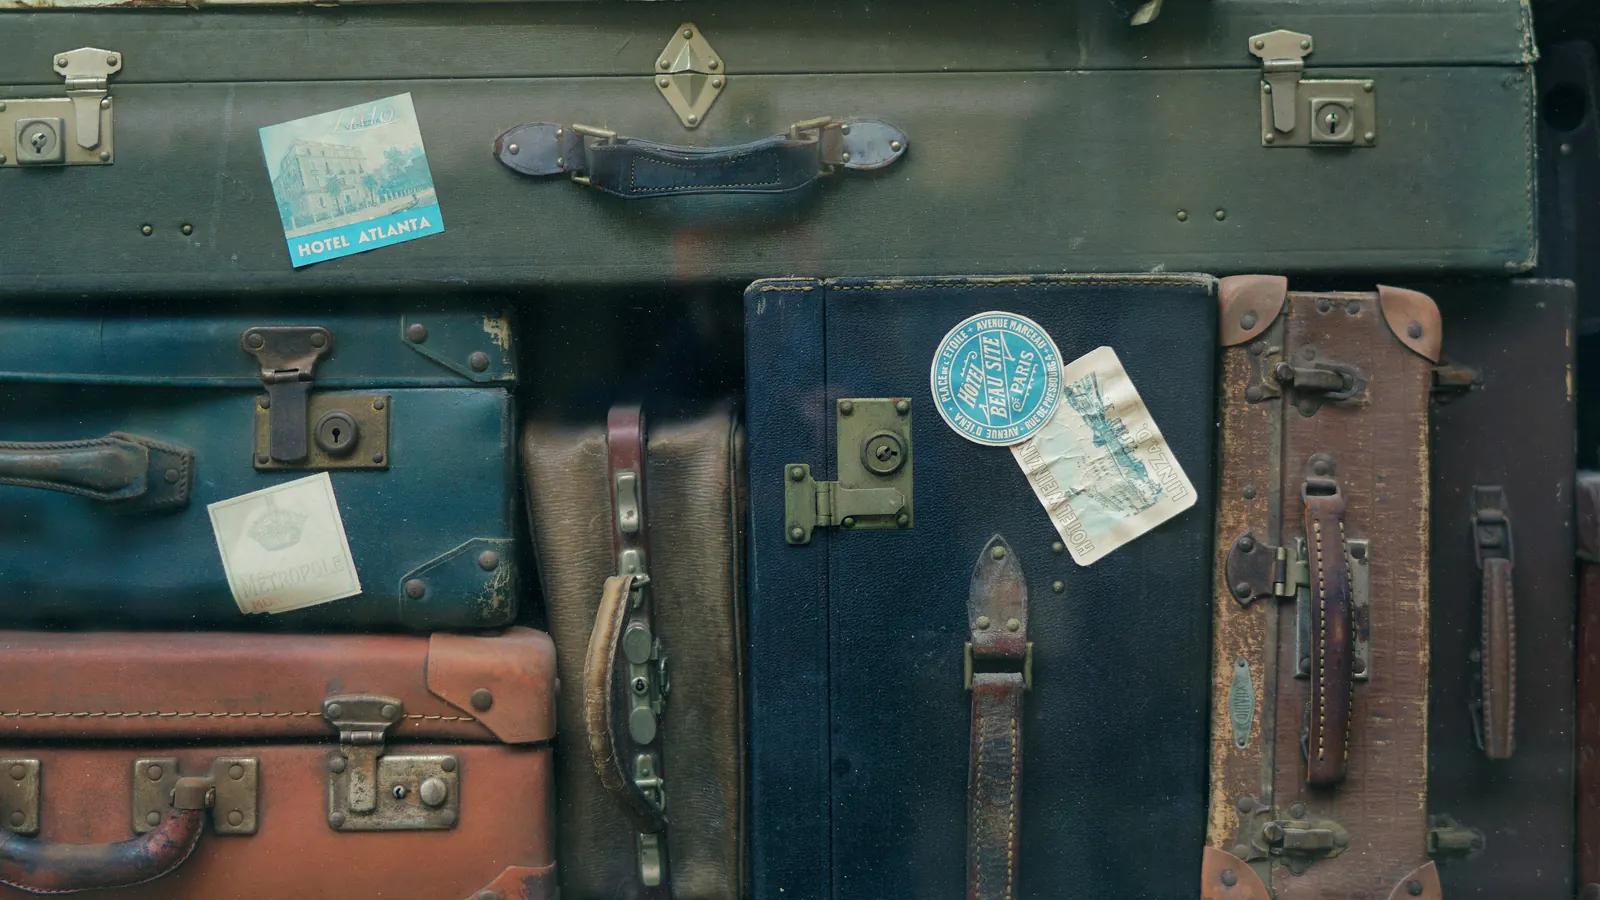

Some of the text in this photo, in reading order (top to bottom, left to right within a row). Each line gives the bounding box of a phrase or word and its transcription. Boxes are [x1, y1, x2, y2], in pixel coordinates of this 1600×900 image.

[344, 118, 382, 131] VENEZIA
[297, 216, 432, 257] HOTEL ATLANTA
[976, 318, 1047, 350] AVENUE MARCEAU
[938, 375, 951, 403] PLACE
[983, 336, 1008, 419] BEAU SITE
[1010, 350, 1034, 395] PARIS
[986, 427, 1019, 439] AVENUE
[1024, 414, 1040, 430] RUE
[1037, 407, 1048, 419] DE
[1149, 452, 1188, 503] LINZ
[1017, 440, 1095, 557] HOTEL WEINZIN
